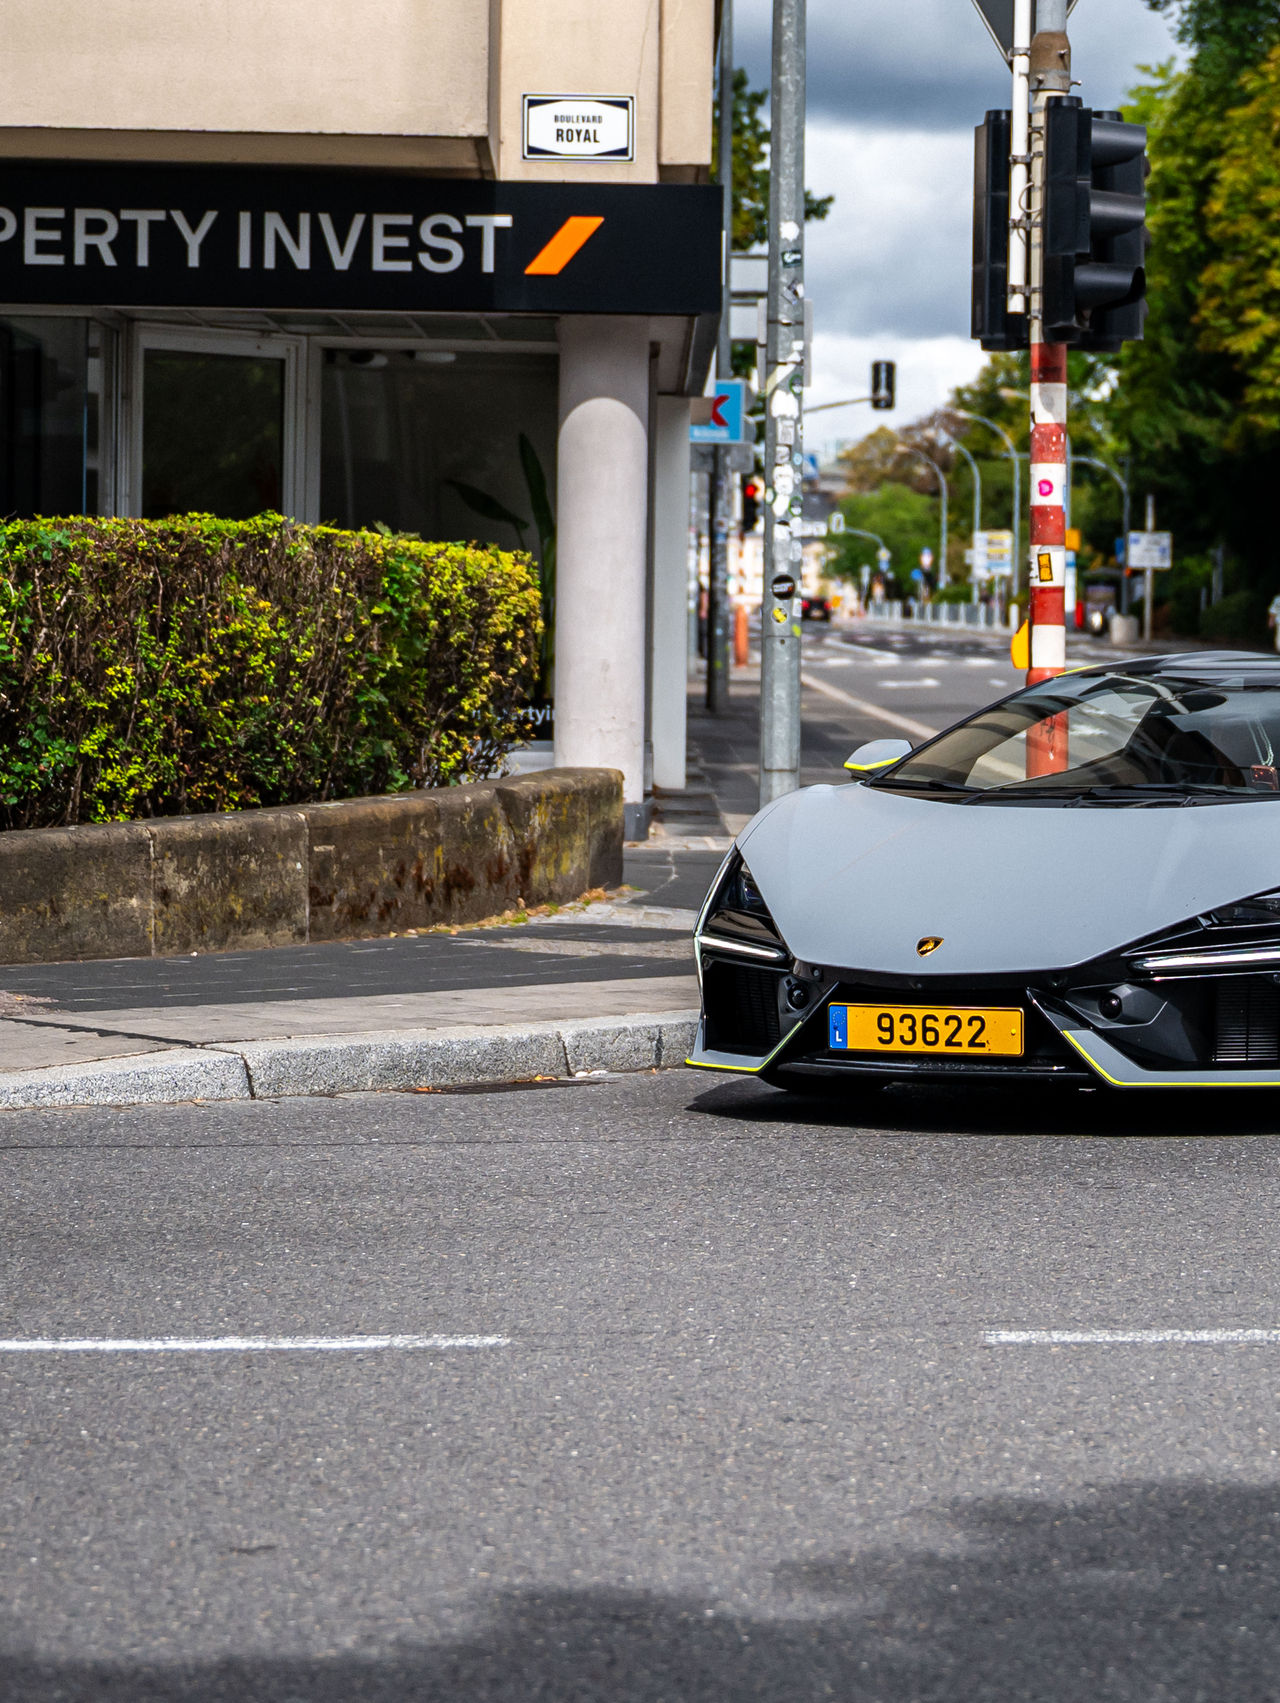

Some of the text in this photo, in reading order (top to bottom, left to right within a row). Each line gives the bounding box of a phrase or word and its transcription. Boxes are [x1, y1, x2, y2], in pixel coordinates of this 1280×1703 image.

[554, 114, 603, 124] BOULEVARD
[556, 128, 600, 143] ROYAL
[238, 210, 513, 274] INVEST
[835, 1012, 986, 1048] L 93622
